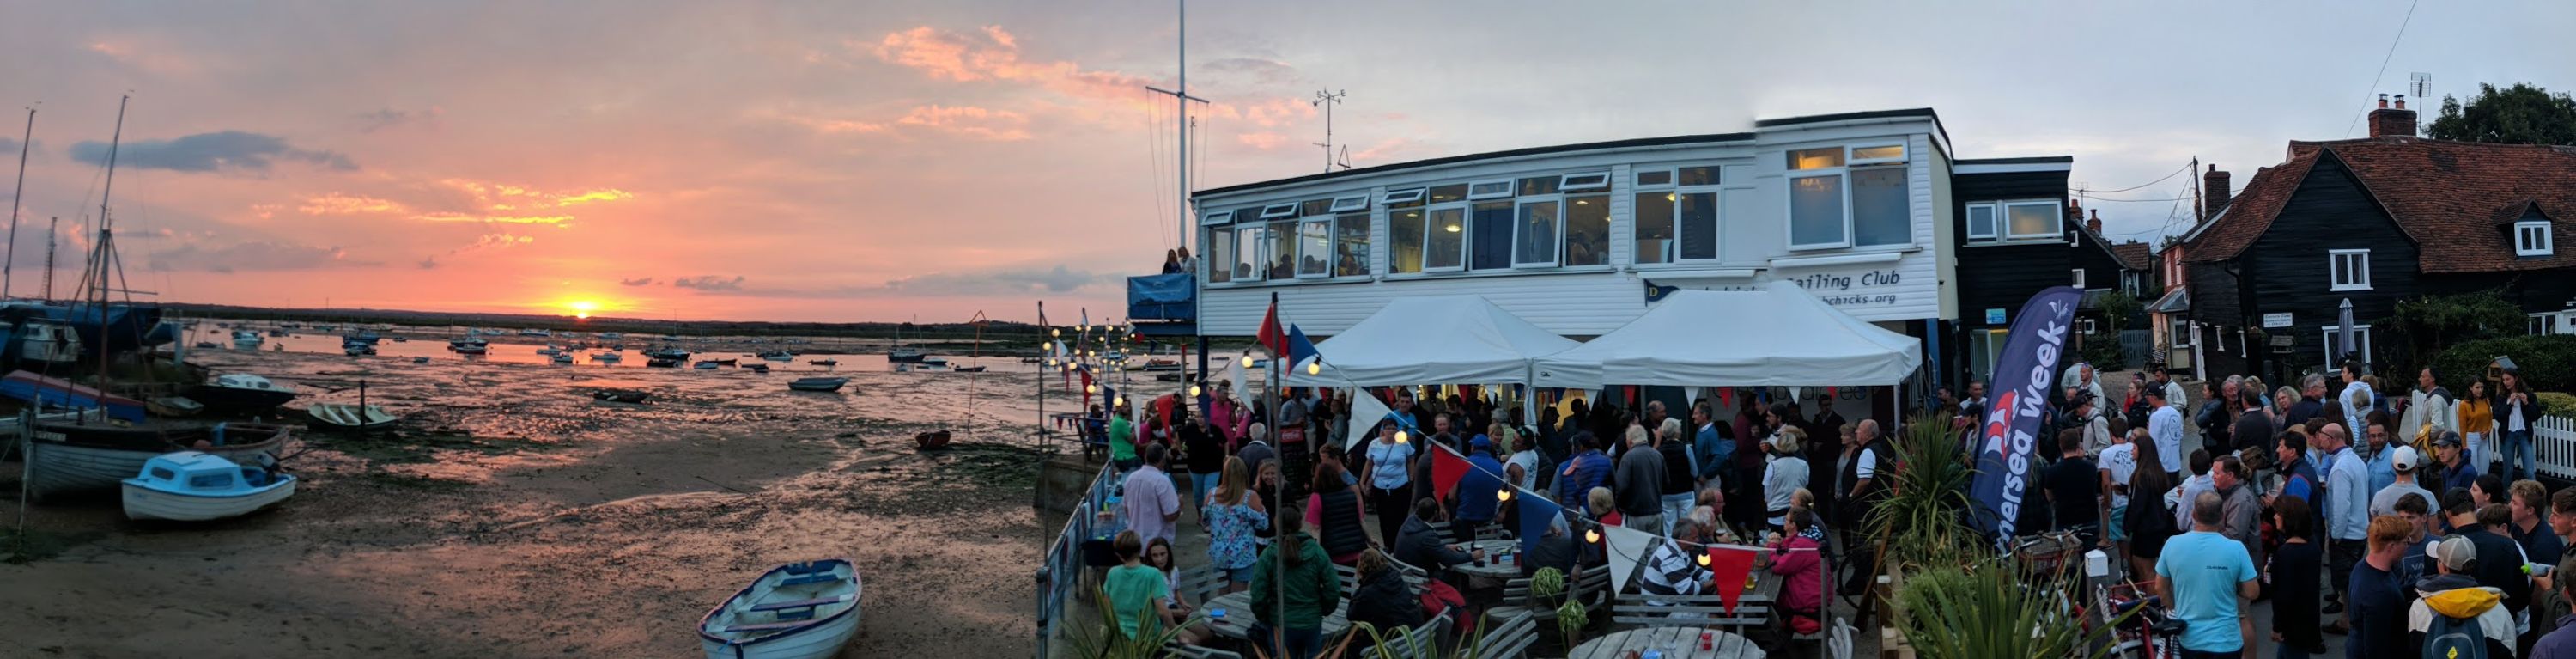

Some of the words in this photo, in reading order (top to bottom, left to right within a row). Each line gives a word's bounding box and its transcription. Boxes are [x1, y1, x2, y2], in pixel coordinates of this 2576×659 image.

[1787, 274, 1850, 290] ailing
[1862, 270, 1900, 285] Club
[1649, 287, 1658, 296] D
[2020, 320, 2065, 418] week
